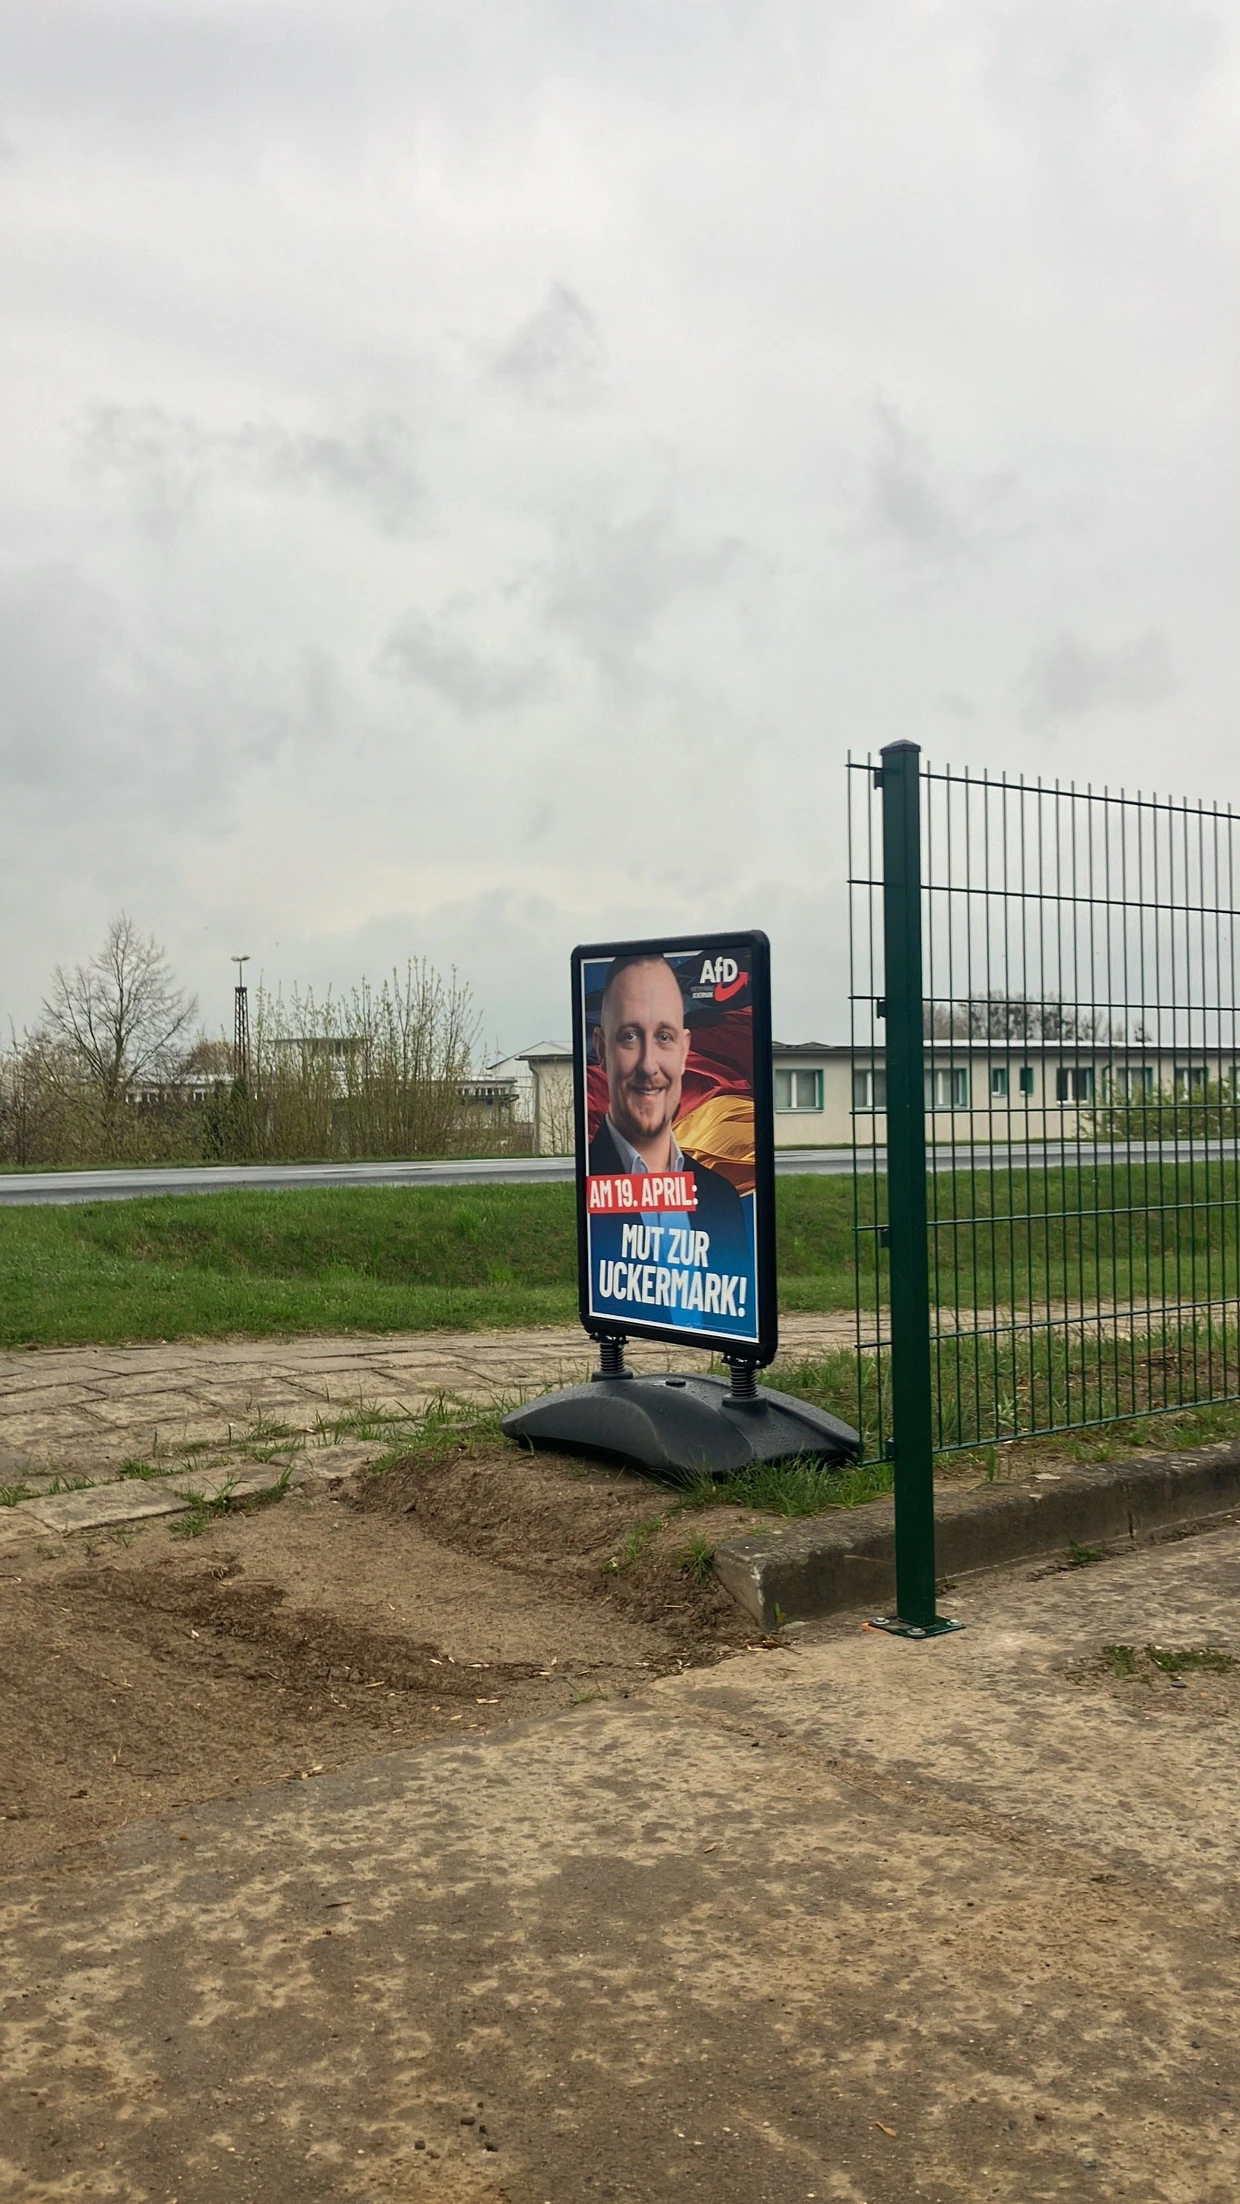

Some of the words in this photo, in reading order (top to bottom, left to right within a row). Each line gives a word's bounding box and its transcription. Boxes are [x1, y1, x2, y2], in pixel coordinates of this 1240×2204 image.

[699, 956, 738, 983] AfD
[590, 1180, 613, 1208] AM
[614, 1178, 638, 1207] 19.
[641, 1176, 699, 1207] APRIL:
[621, 1223, 665, 1262] MUT
[667, 1228, 710, 1267] ZUR
[599, 1259, 748, 1317] UCKERMARK!
